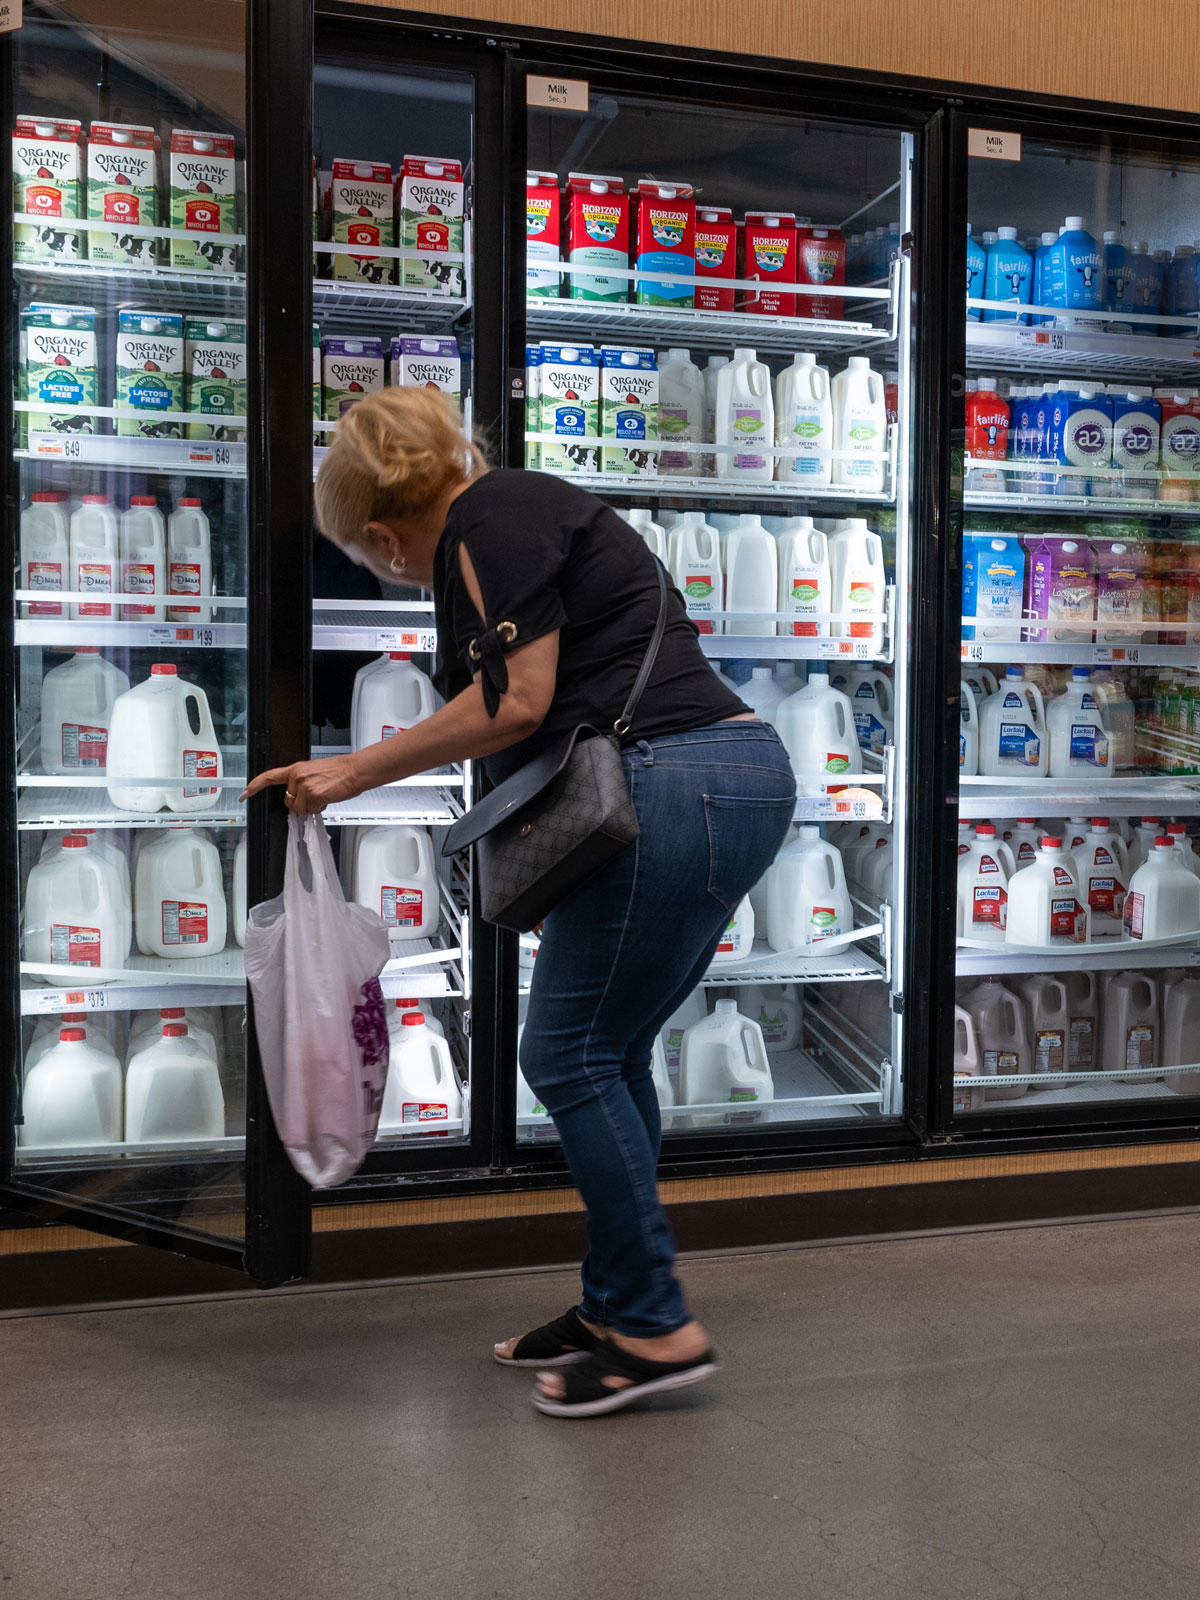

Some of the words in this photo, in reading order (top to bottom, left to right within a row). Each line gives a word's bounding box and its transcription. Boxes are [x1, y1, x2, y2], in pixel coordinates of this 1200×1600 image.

[548, 85, 567, 94] Milk
[986, 137, 1003, 146] Milk
[17, 147, 71, 163] ORGANIC
[22, 157, 67, 170] VALLEY
[95, 154, 148, 170] ORGANIC
[101, 164, 145, 177] VALLEY
[177, 163, 229, 177] ORGANIC
[182, 172, 224, 185] VALLEY
[340, 188, 388, 201] ORGANIC
[410, 186, 457, 200] ORGANIC
[345, 197, 384, 208] VALLEY
[415, 195, 453, 207] VALLEY
[582, 204, 621, 215] HORIZON
[650, 210, 688, 221] HORIZON
[753, 237, 789, 246] HORIZON
[805, 248, 838, 258] HORIZON
[1070, 252, 1103, 266] fairlife
[1000, 261, 1030, 274] fairlife
[34, 336, 88, 349] ORGANIC
[40, 345, 84, 357] VALLEY
[124, 342, 177, 356] ORGANIC
[130, 352, 173, 363] VALLEY
[192, 349, 243, 362] ORGANIC
[197, 358, 237, 369] VALLEY
[331, 364, 378, 377] ORGANIC
[408, 364, 455, 376] ORGANIC
[336, 373, 375, 384] VALLEY
[412, 373, 451, 384] VALLEY
[549, 373, 593, 384] ORGANIC
[610, 377, 654, 388] ORGANIC
[43, 384, 79, 392] LACTOSE
[553, 381, 590, 392] VALLEY
[614, 385, 650, 396] VALLEY
[132, 389, 168, 397] LACTOSE
[141, 396, 160, 404] FREE
[977, 414, 1008, 426] fairlife
[1078, 430, 1101, 447] a2
[1126, 434, 1149, 449] a2
[1175, 435, 1196, 449] a2
[992, 596, 1009, 604] MILK
[1112, 600, 1129, 608] MILK
[1054, 902, 1073, 910] Lactaid
